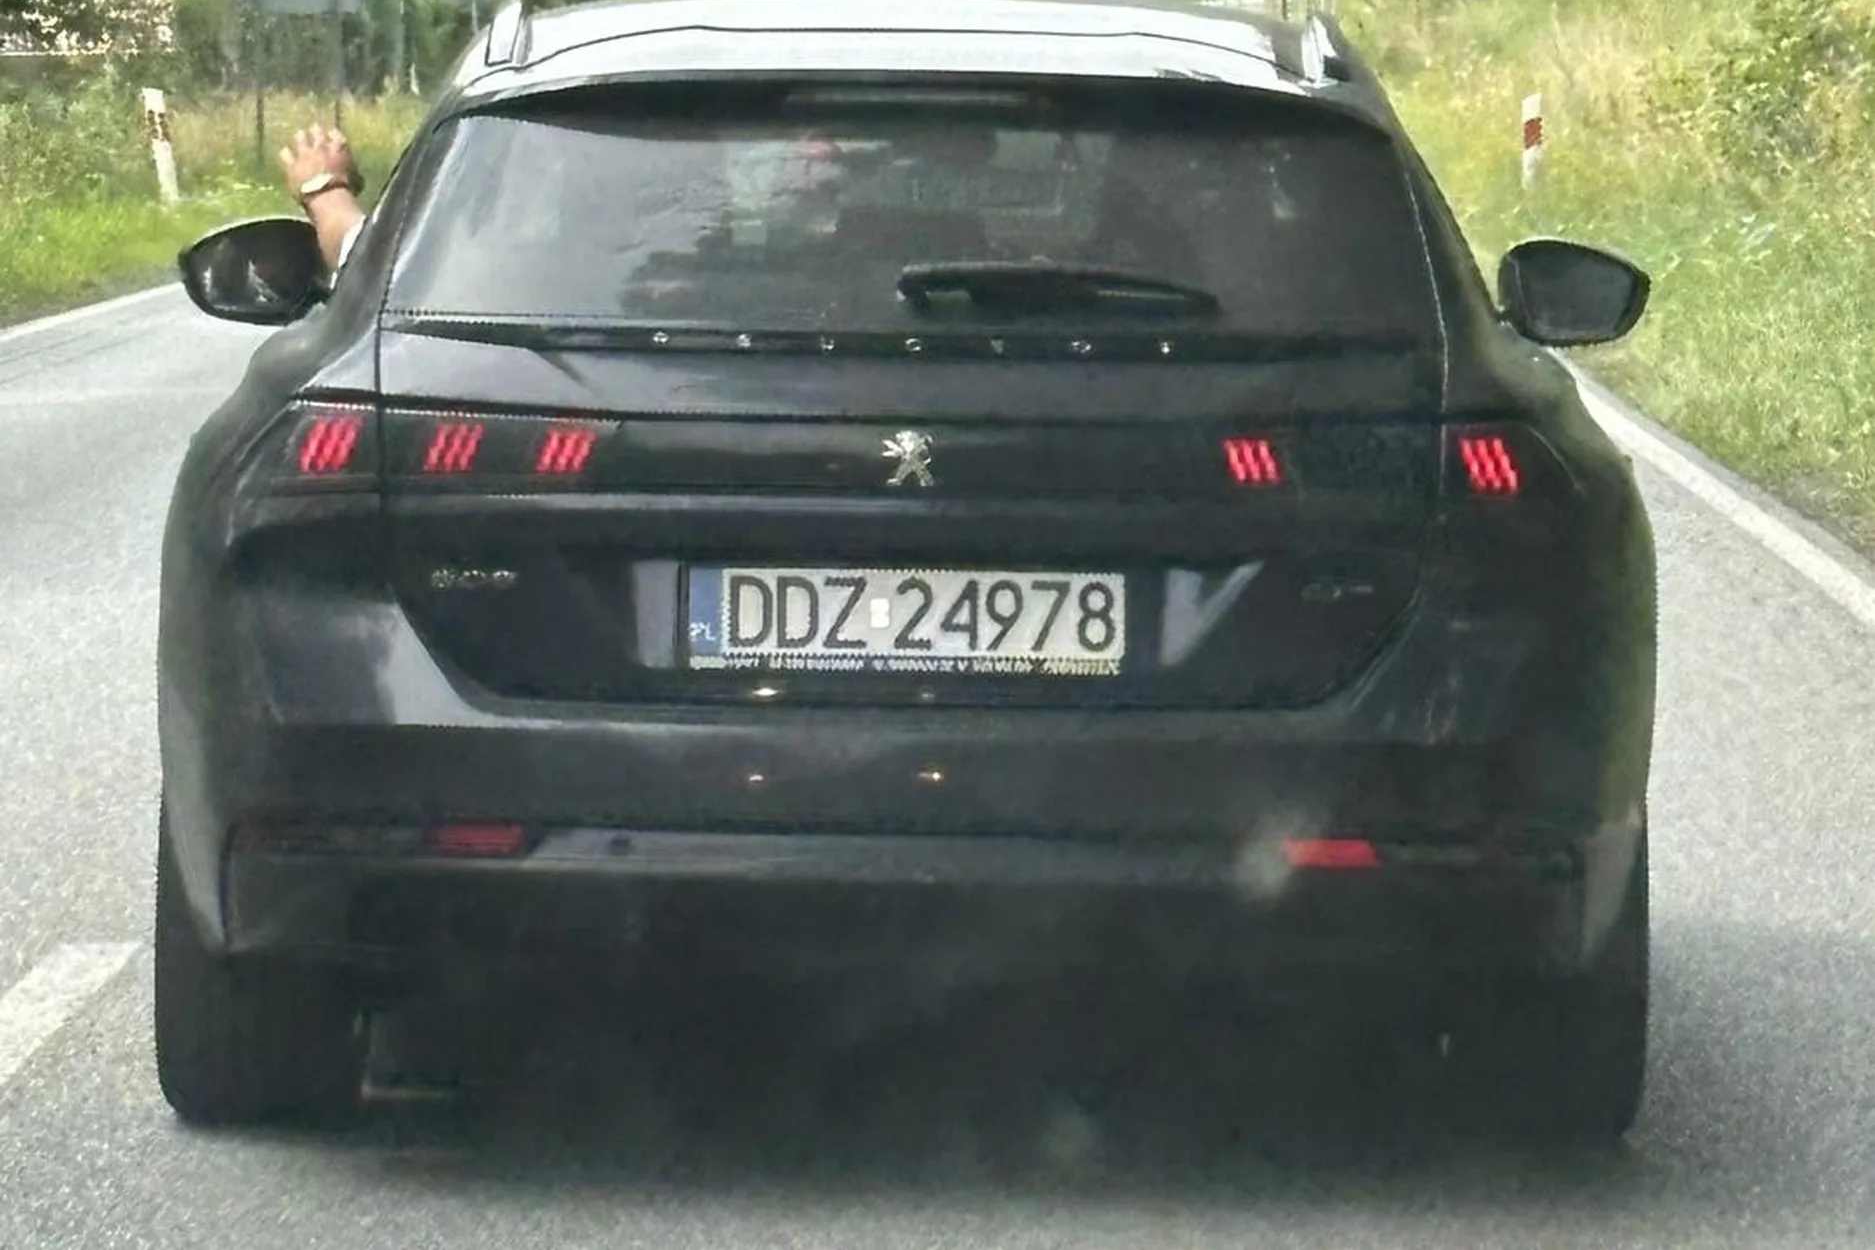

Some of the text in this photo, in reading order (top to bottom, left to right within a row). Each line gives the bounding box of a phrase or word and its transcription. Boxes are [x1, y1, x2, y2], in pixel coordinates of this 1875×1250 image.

[689, 621, 716, 641] PL
[728, 575, 1116, 650] DDZ 24978
